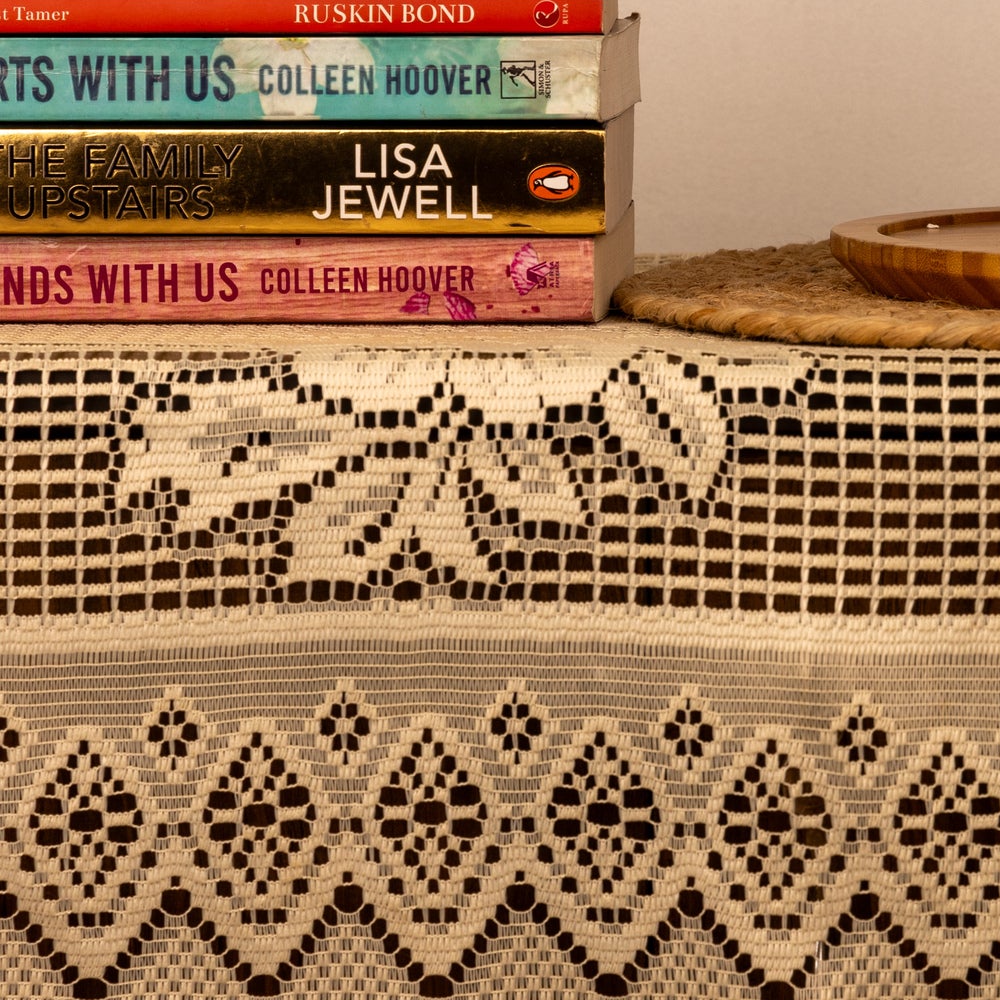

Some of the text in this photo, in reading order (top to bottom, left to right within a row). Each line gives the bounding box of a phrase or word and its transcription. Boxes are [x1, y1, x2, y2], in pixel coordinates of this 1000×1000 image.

[0, 6, 70, 21] t Tamer
[294, 4, 475, 24] RUSKIN BOND
[68, 55, 171, 102] WITH
[185, 55, 236, 102] US
[258, 64, 492, 95] COLLEEN HOOVER
[544, 60, 552, 99] SCHUSTER
[0, 144, 244, 180] HE FAMILY
[354, 143, 453, 179] LISA
[7, 184, 215, 221] UPSTAIRS
[312, 185, 493, 220] JEWELL
[88, 263, 178, 304] WITH
[195, 262, 240, 302] US
[260, 265, 474, 294] COLLEEN HOOVER
